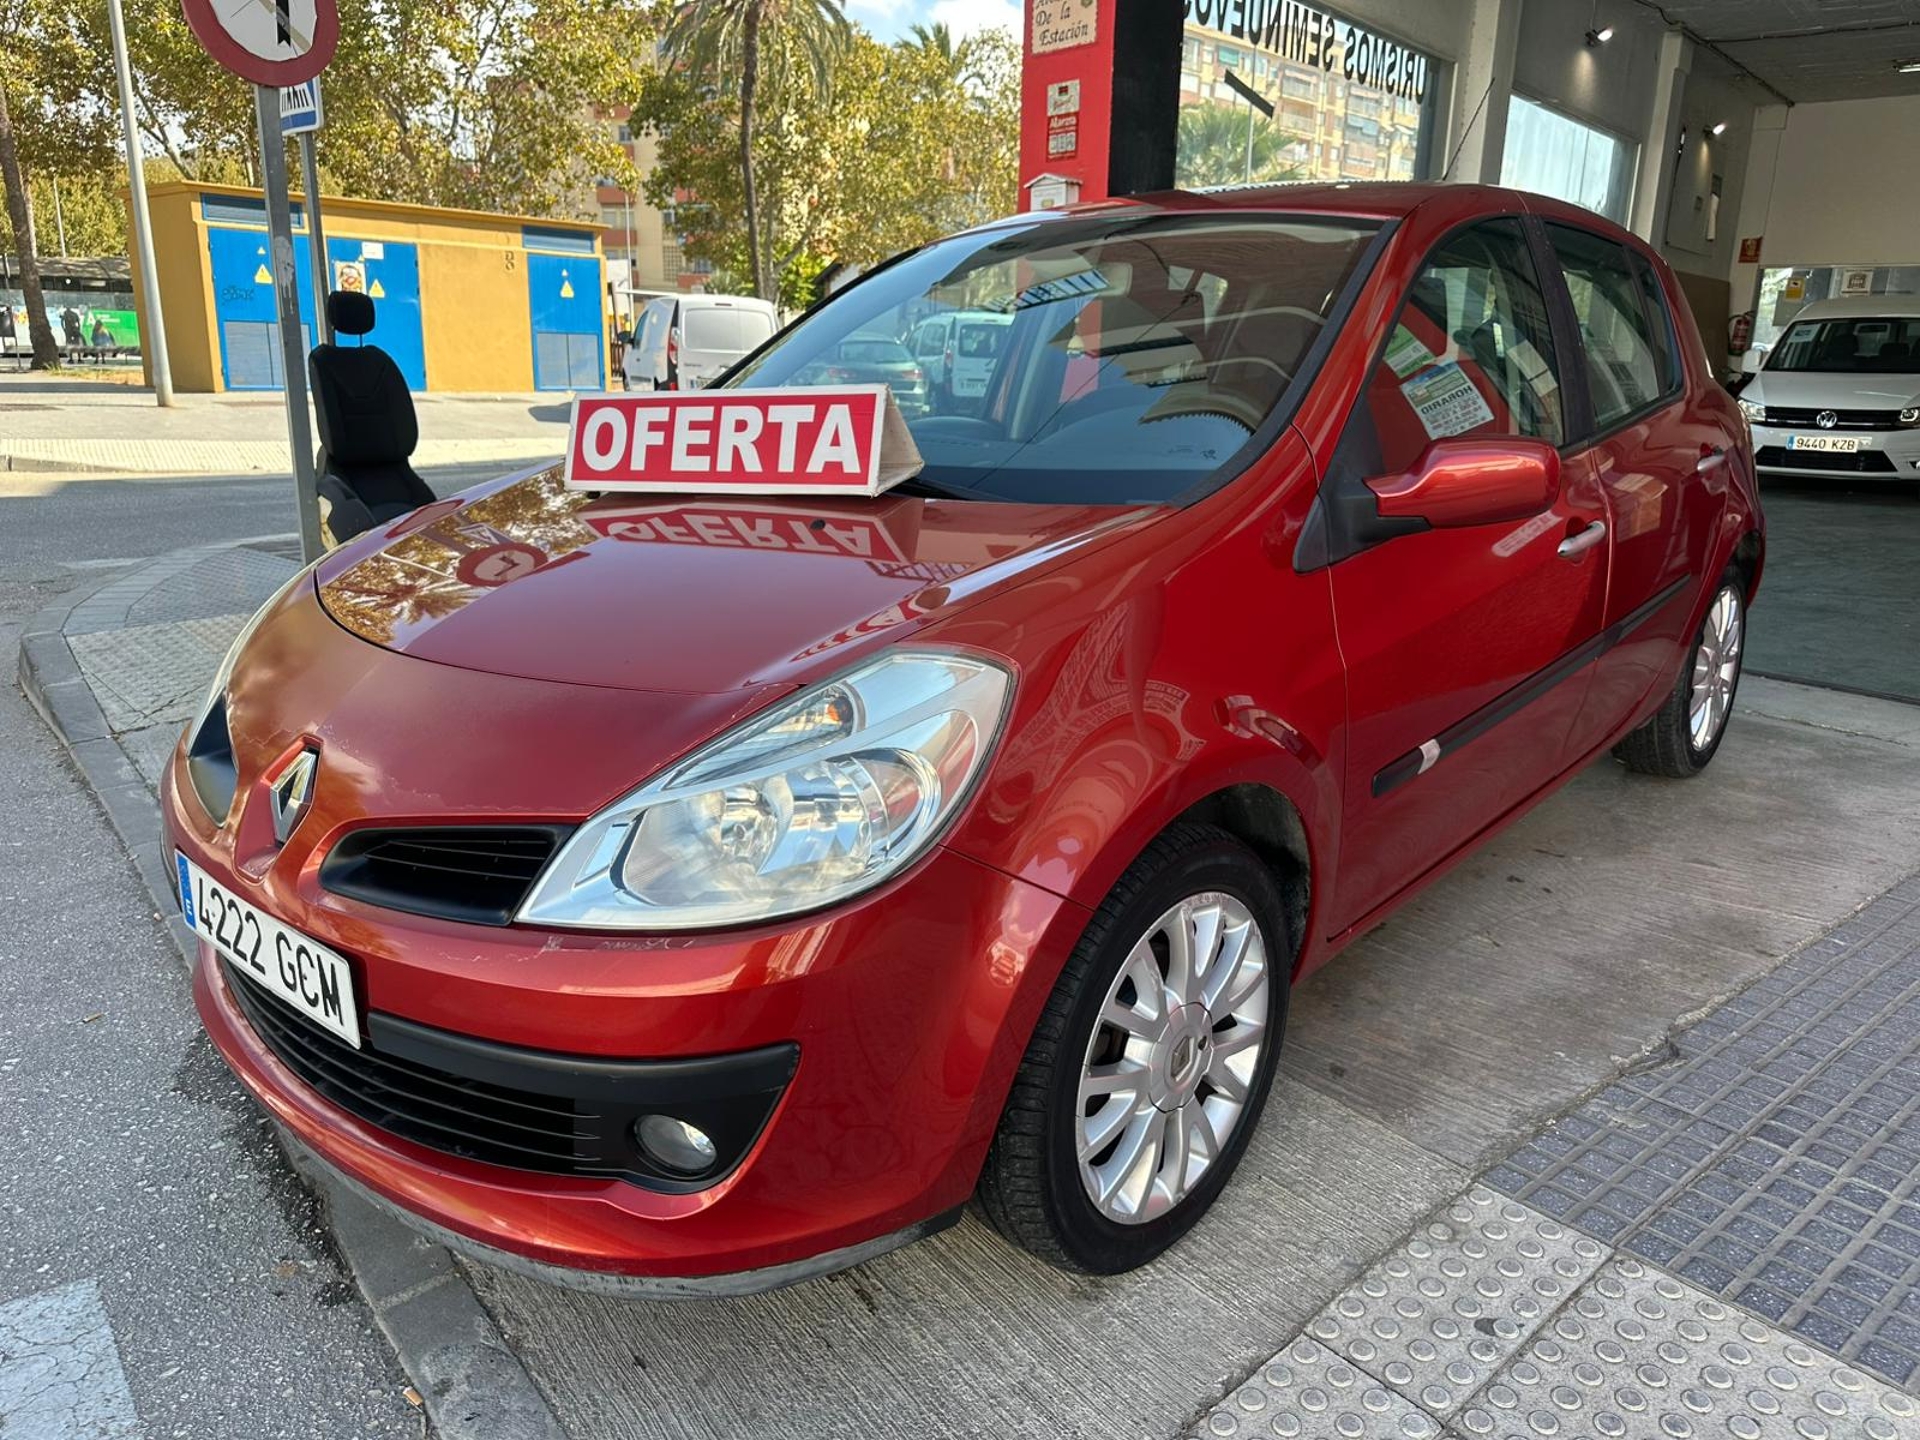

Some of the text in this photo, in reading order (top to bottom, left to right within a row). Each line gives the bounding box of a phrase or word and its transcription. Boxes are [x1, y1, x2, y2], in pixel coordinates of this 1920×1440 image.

[1036, 10, 1052, 26] De
[1060, 1, 1071, 20] la
[1039, 20, 1089, 46] Estación
[582, 404, 861, 473] OFERTA
[1796, 438, 1855, 451] 9440 KZB
[198, 877, 345, 1027] 4222 GCM
